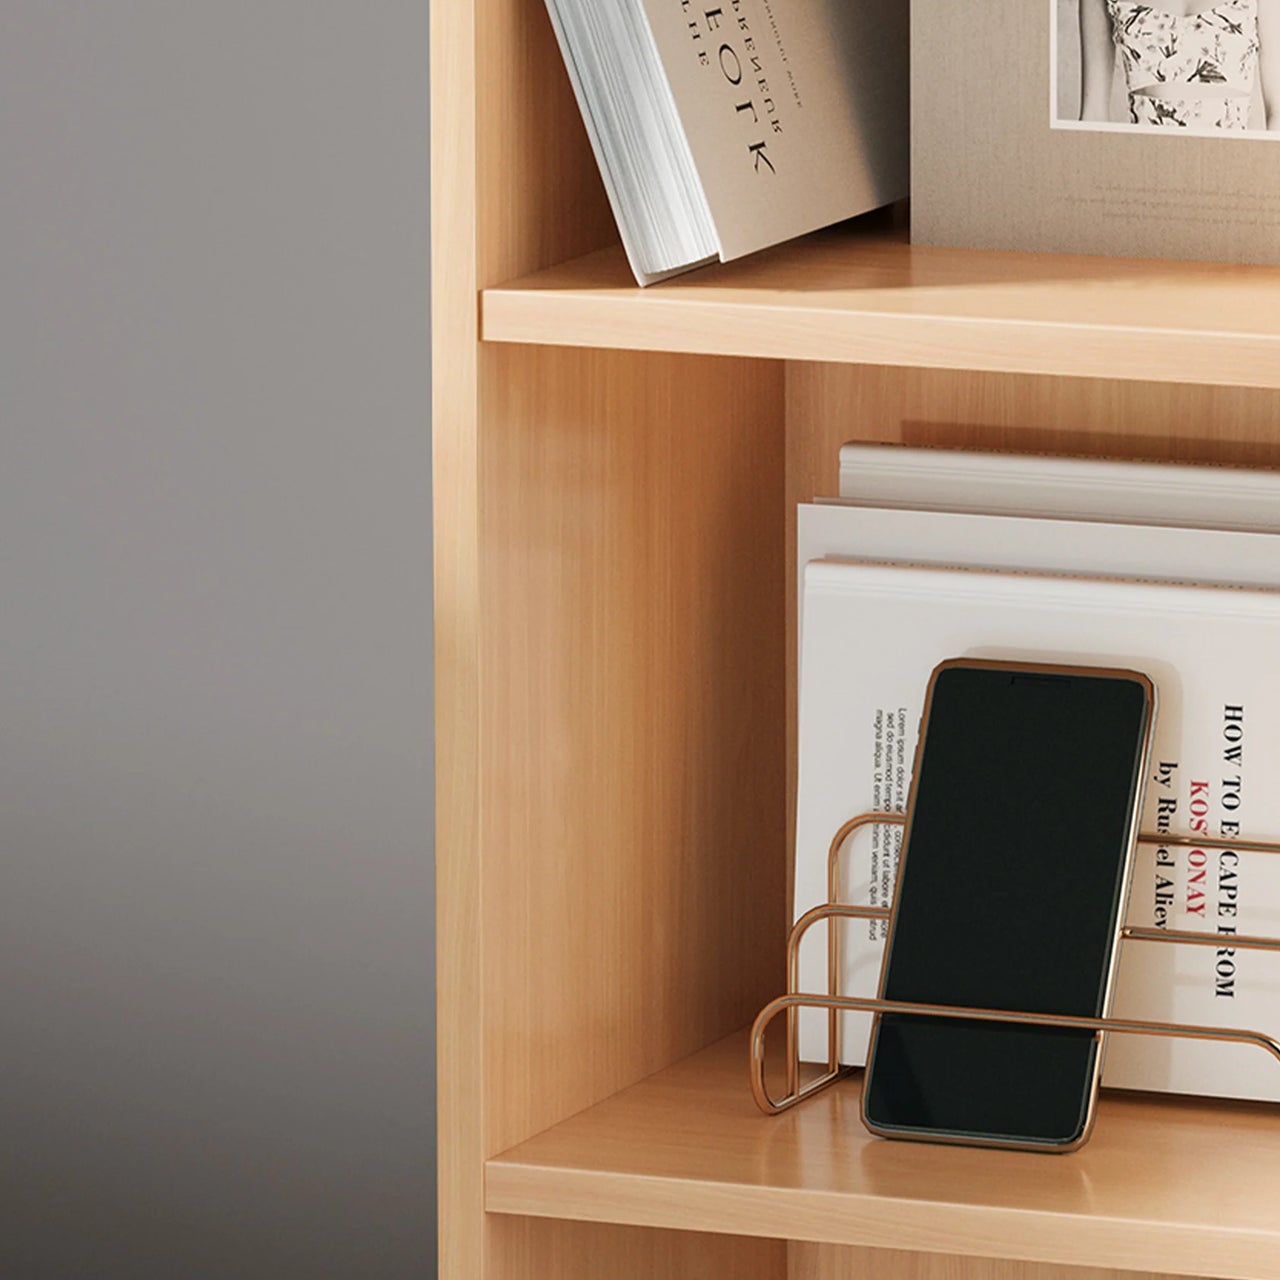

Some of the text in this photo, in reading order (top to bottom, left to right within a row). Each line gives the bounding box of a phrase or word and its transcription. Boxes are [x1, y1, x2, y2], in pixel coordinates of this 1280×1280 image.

[1223, 704, 1244, 768] HOW
[1153, 760, 1179, 789] by
[1221, 775, 1242, 811] TO
[1218, 820, 1240, 917] ECAPE
